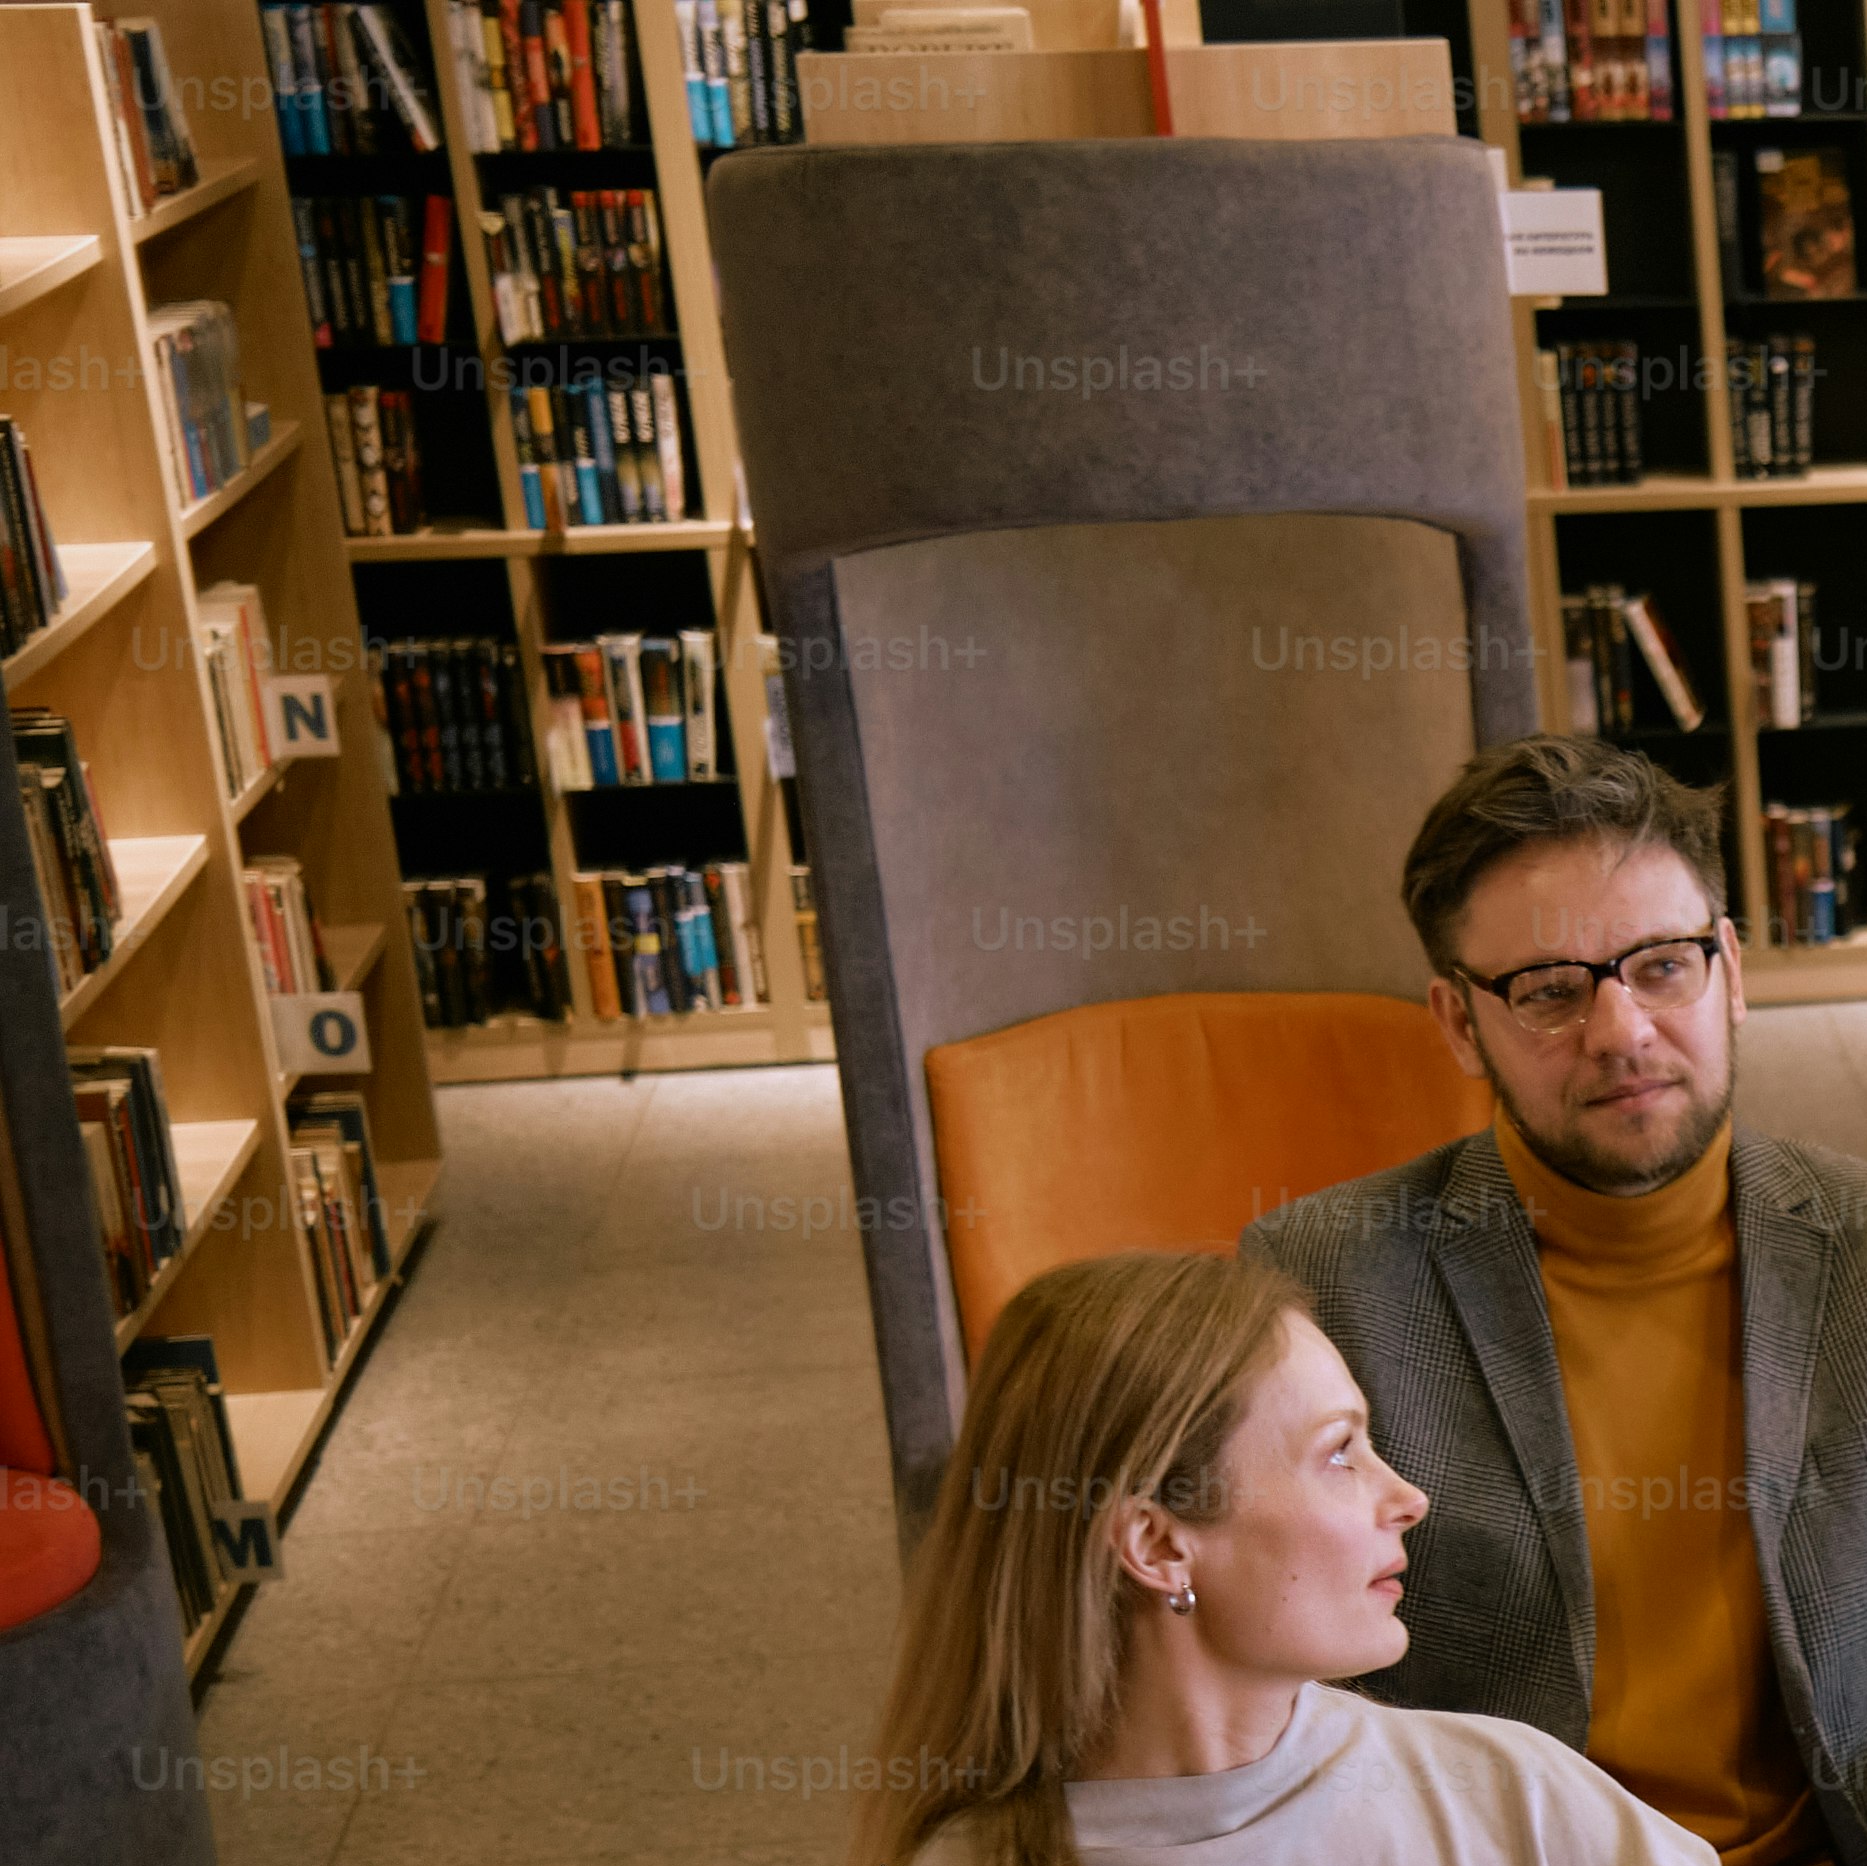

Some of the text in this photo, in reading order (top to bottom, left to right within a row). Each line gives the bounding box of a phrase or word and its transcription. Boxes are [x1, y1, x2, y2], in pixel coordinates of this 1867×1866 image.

[281, 693, 327, 741] N
[309, 1010, 357, 1056] O
[212, 1518, 273, 1568] M
